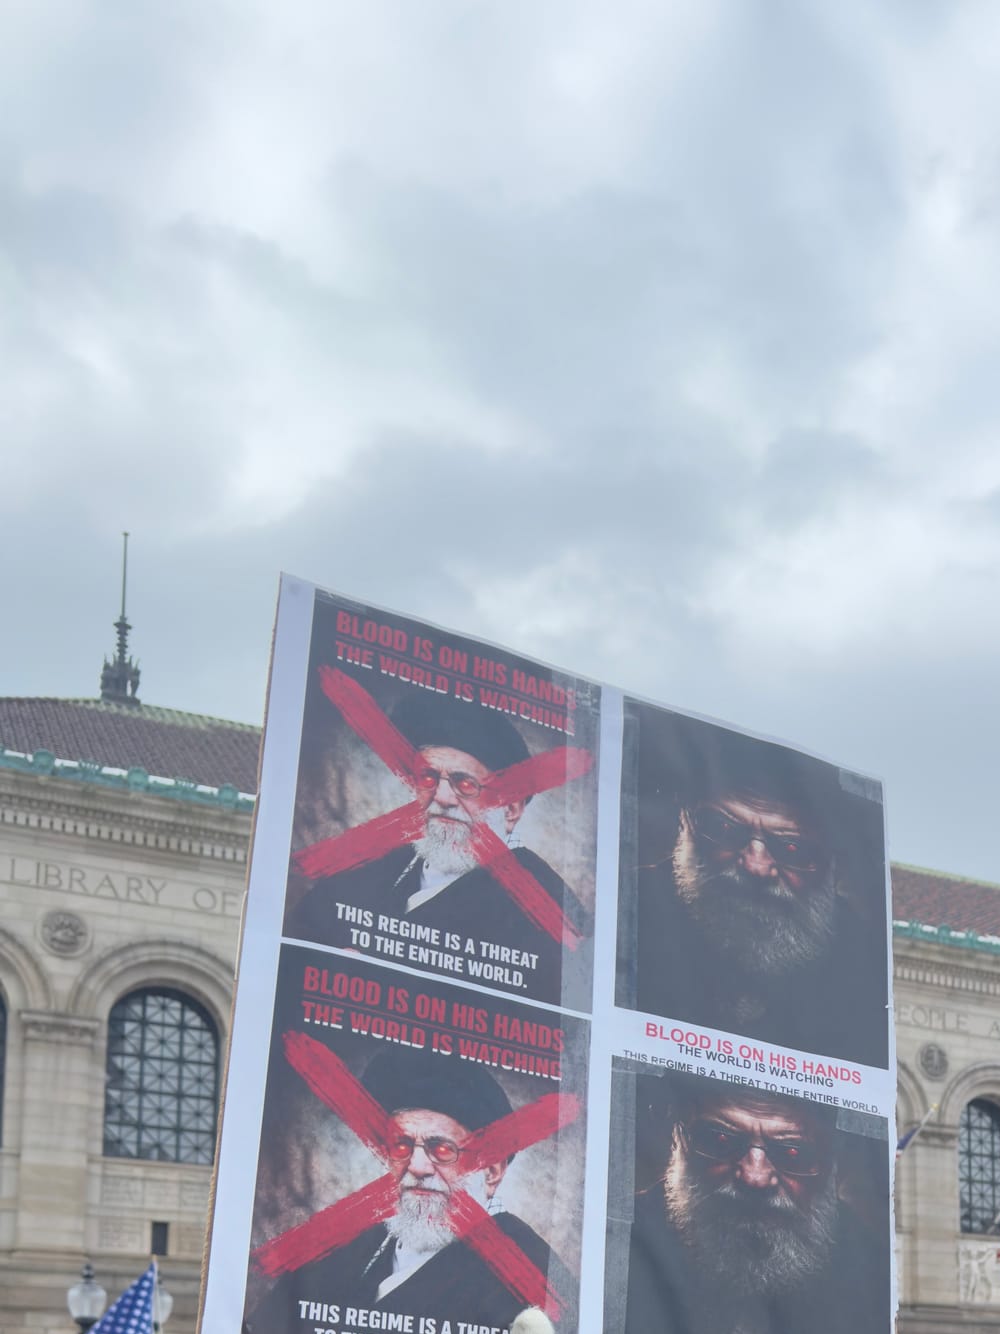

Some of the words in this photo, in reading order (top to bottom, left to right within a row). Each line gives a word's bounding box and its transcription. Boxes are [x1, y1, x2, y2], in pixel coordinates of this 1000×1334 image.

[335, 641, 373, 669] THE
[380, 655, 449, 694] WORLD
[455, 681, 473, 702] IS
[479, 687, 575, 736] WATCHING
[337, 610, 407, 652] BLOOD
[414, 636, 433, 662] IS
[439, 646, 467, 674] ON
[473, 656, 506, 686] HIS
[512, 669, 577, 711] HANDS
[9, 858, 167, 906] LIBRARY
[193, 888, 239, 914] OF
[336, 902, 373, 928] THIS
[378, 914, 440, 945] REGIME
[445, 932, 461, 951] IS
[464, 939, 475, 954] A
[480, 941, 539, 969] THREAT
[350, 928, 370, 948] TO
[374, 935, 404, 957] THE
[408, 945, 464, 973] ENTIRE
[468, 960, 528, 988] WORLD.
[304, 966, 381, 1006] BLOOD
[387, 986, 409, 1014] IS
[415, 994, 446, 1023] ON
[452, 1003, 488, 1033] HIS
[494, 1013, 565, 1051] HANDS
[895, 1004, 968, 1033] EOPLE
[301, 1001, 344, 1029] THE
[350, 1012, 425, 1048] WORLD
[432, 1032, 453, 1055] IS
[459, 1038, 562, 1081] WATCHING
[645, 1022, 711, 1049] BLOOD
[717, 1039, 734, 1055] IS
[738, 1044, 764, 1063] ON
[769, 1052, 797, 1071] HIS
[802, 1061, 863, 1085] HANDS
[677, 1043, 702, 1058] THE
[706, 1048, 752, 1070] WORLD
[755, 1061, 767, 1074] IS
[769, 1065, 834, 1088] WATCHING
[623, 1049, 648, 1062] THIS
[651, 1056, 693, 1074] REGIME
[696, 1066, 707, 1077] IS
[709, 1069, 717, 1079] A
[720, 1071, 762, 1089] THREAT
[764, 1081, 778, 1093] TO
[780, 1085, 800, 1097] THE
[803, 1090, 839, 1105] ENTIRE
[842, 1098, 881, 1115] WORLD.
[299, 1300, 340, 1324] THIS
[345, 1308, 414, 1333] REGIME
